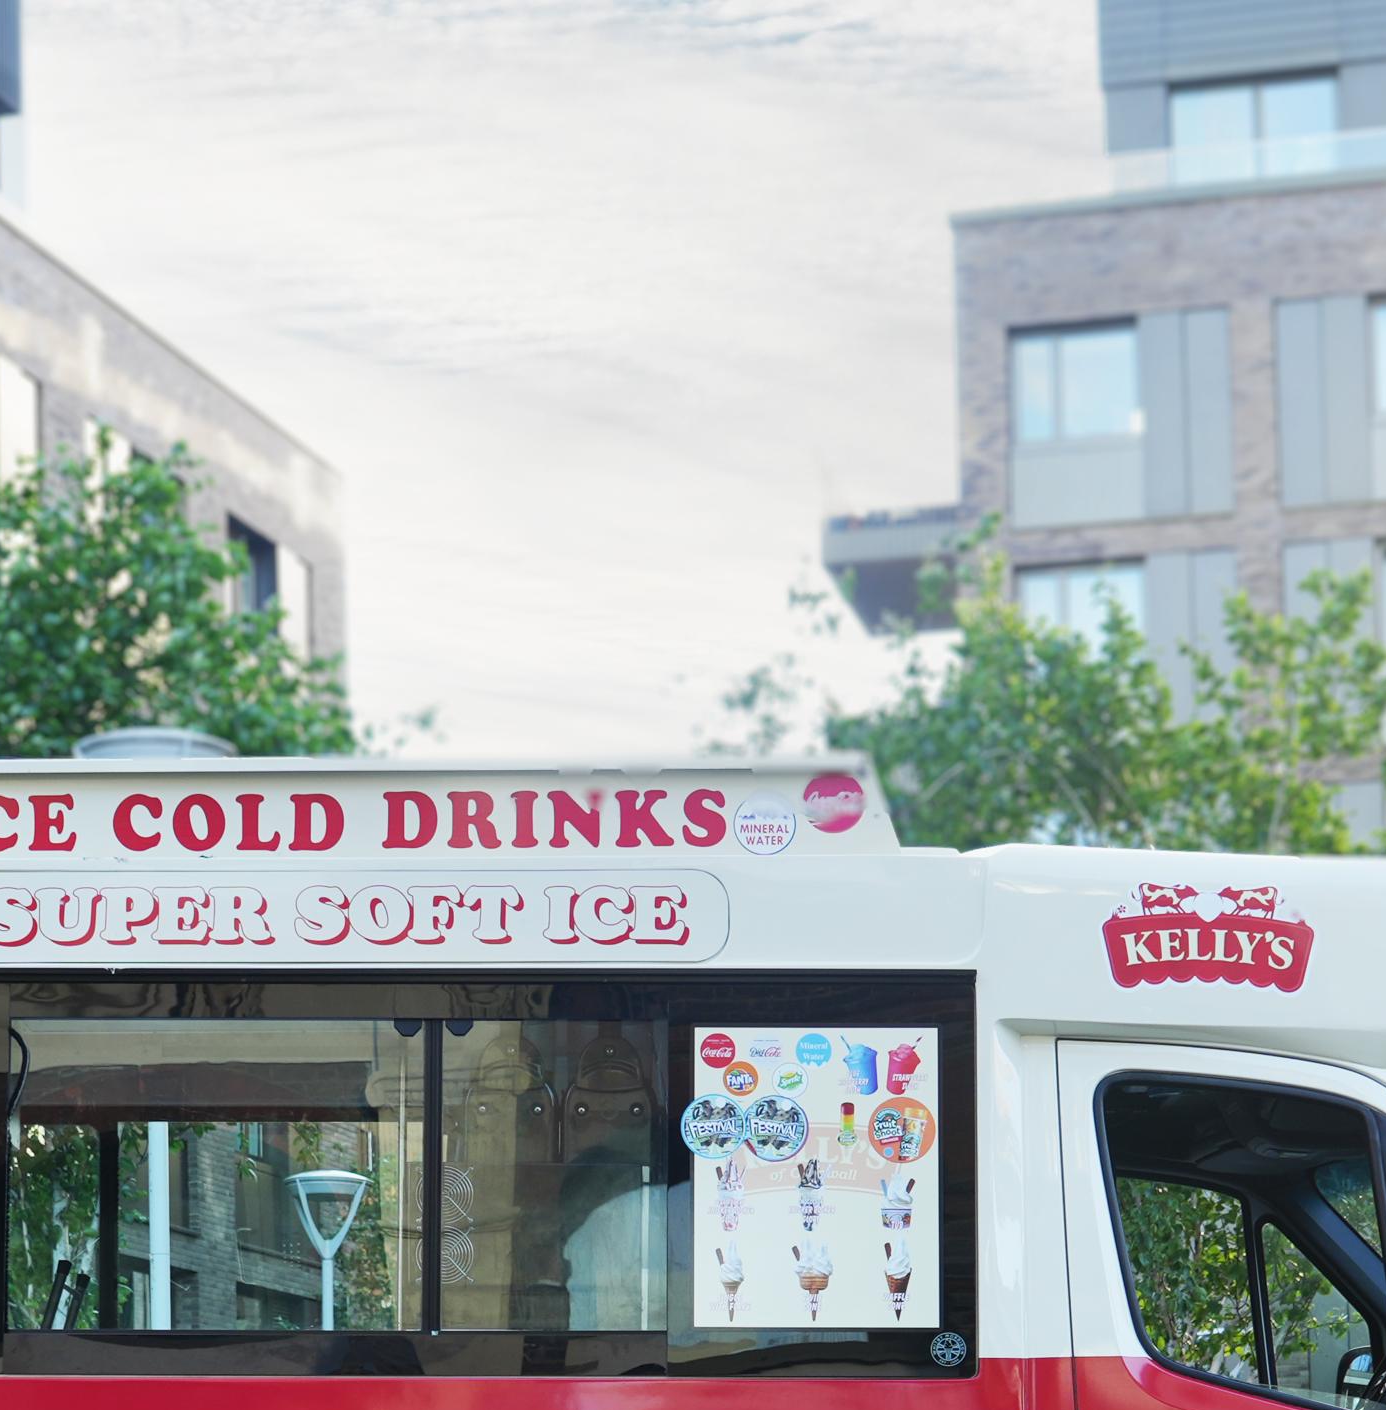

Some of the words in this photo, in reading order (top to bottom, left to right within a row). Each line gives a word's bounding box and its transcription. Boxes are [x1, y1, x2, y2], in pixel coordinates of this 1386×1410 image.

[112, 793, 345, 852] COLD
[382, 788, 727, 851] DRINKS
[739, 823, 790, 834] MINERAL
[745, 835, 785, 846] WATER
[294, 884, 525, 945] SOFT
[542, 884, 690, 946] ICE
[1121, 928, 1295, 970] KELLY'S
[799, 1041, 828, 1051] Mineral
[802, 1052, 825, 1061] Water
[689, 1119, 738, 1139] FESTIVAL
[749, 1119, 798, 1140] FESTIVAL
[873, 1118, 898, 1132] Fruit
[874, 1127, 903, 1139] Shoot
